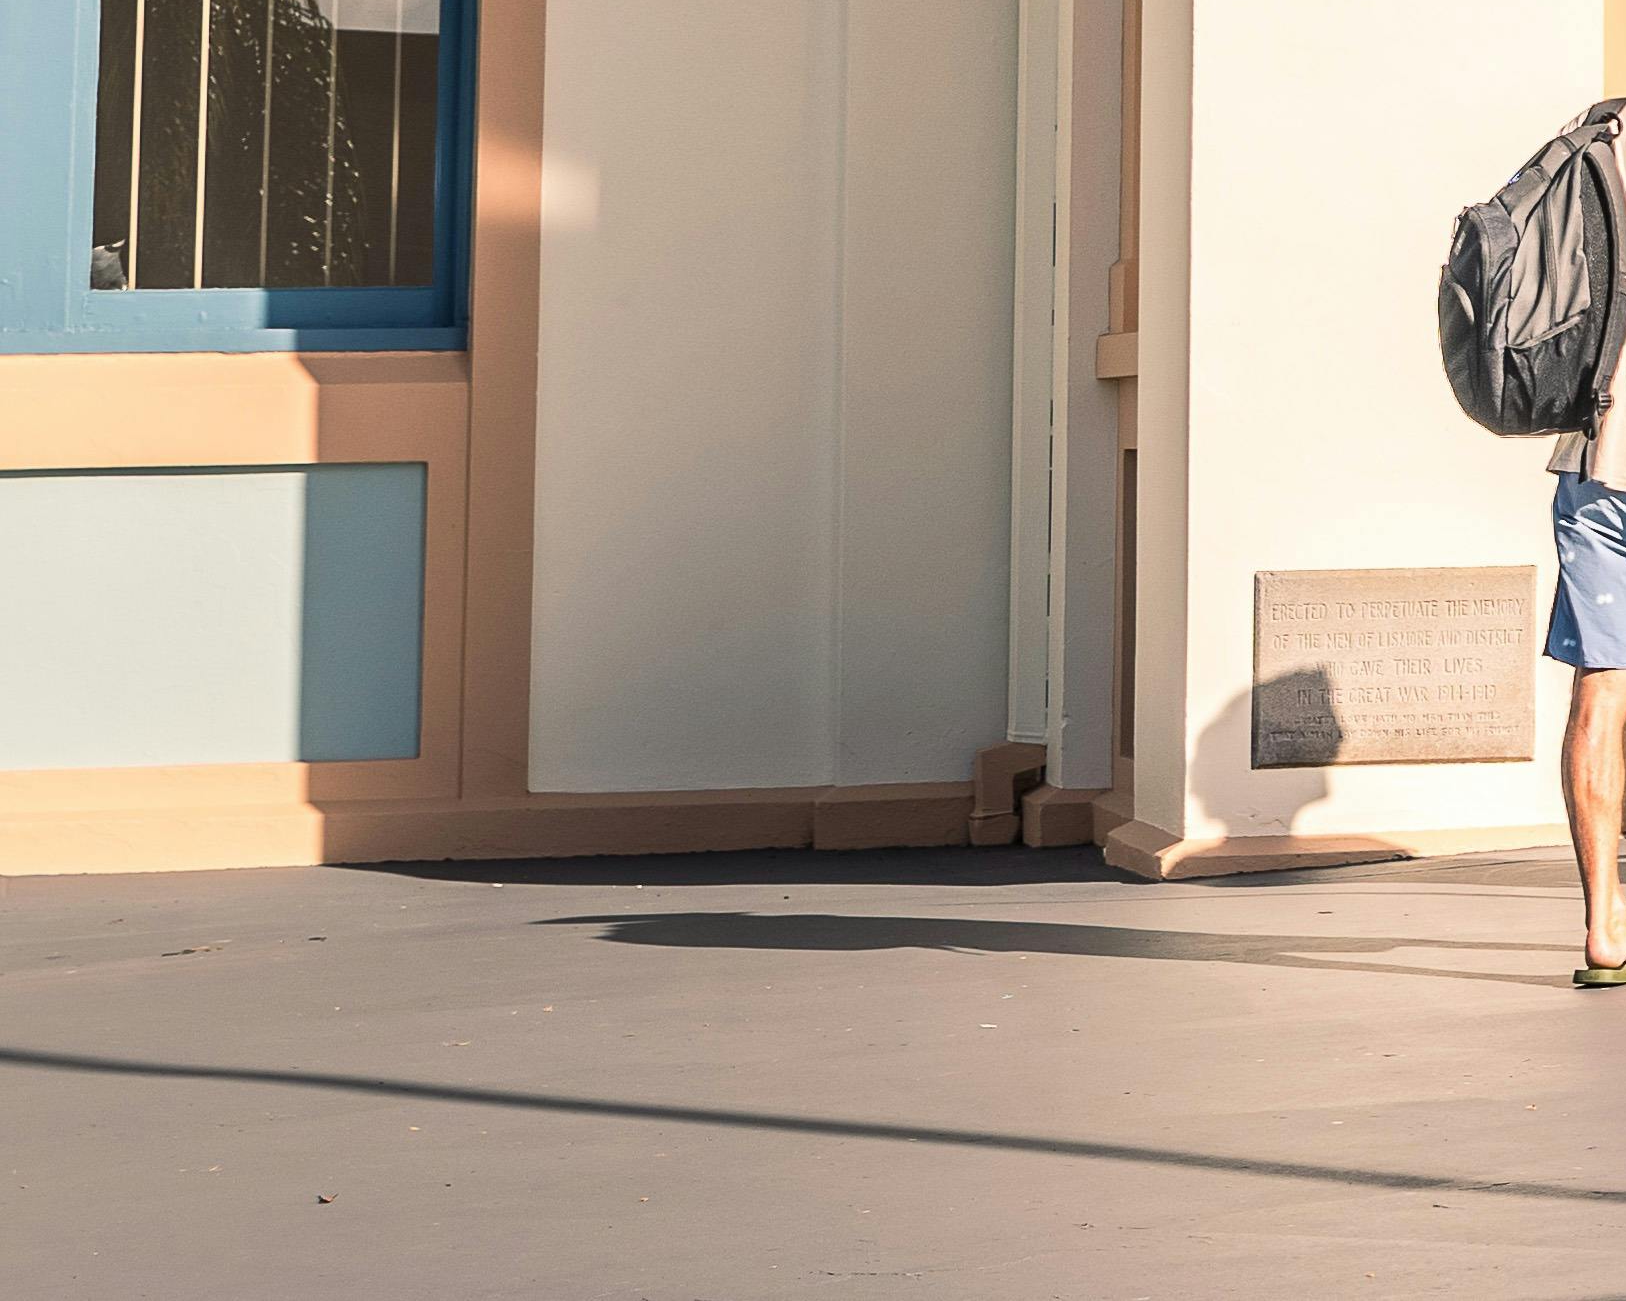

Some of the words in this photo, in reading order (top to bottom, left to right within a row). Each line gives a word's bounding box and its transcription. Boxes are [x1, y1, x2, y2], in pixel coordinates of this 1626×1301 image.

[1272, 602, 1328, 621] ERECTED
[1336, 601, 1356, 619] TO
[1360, 600, 1439, 618] PERPETUATE
[1444, 599, 1469, 617] THE
[1472, 598, 1525, 616] MEMORY
[1273, 633, 1290, 649] OF
[1297, 633, 1321, 649] THE
[1326, 632, 1353, 649] MEN
[1359, 631, 1375, 648] OF
[1378, 630, 1433, 648] LISMORE
[1438, 630, 1462, 647] AND
[1465, 628, 1523, 647] DISTRICT
[1350, 660, 1384, 677] GAVE
[1393, 658, 1432, 676] THEIR
[1444, 657, 1484, 674] LIVES
[1297, 689, 1312, 705] IN
[1319, 688, 1344, 704] THE
[1349, 687, 1392, 704] GREAT
[1398, 686, 1430, 702] WAR
